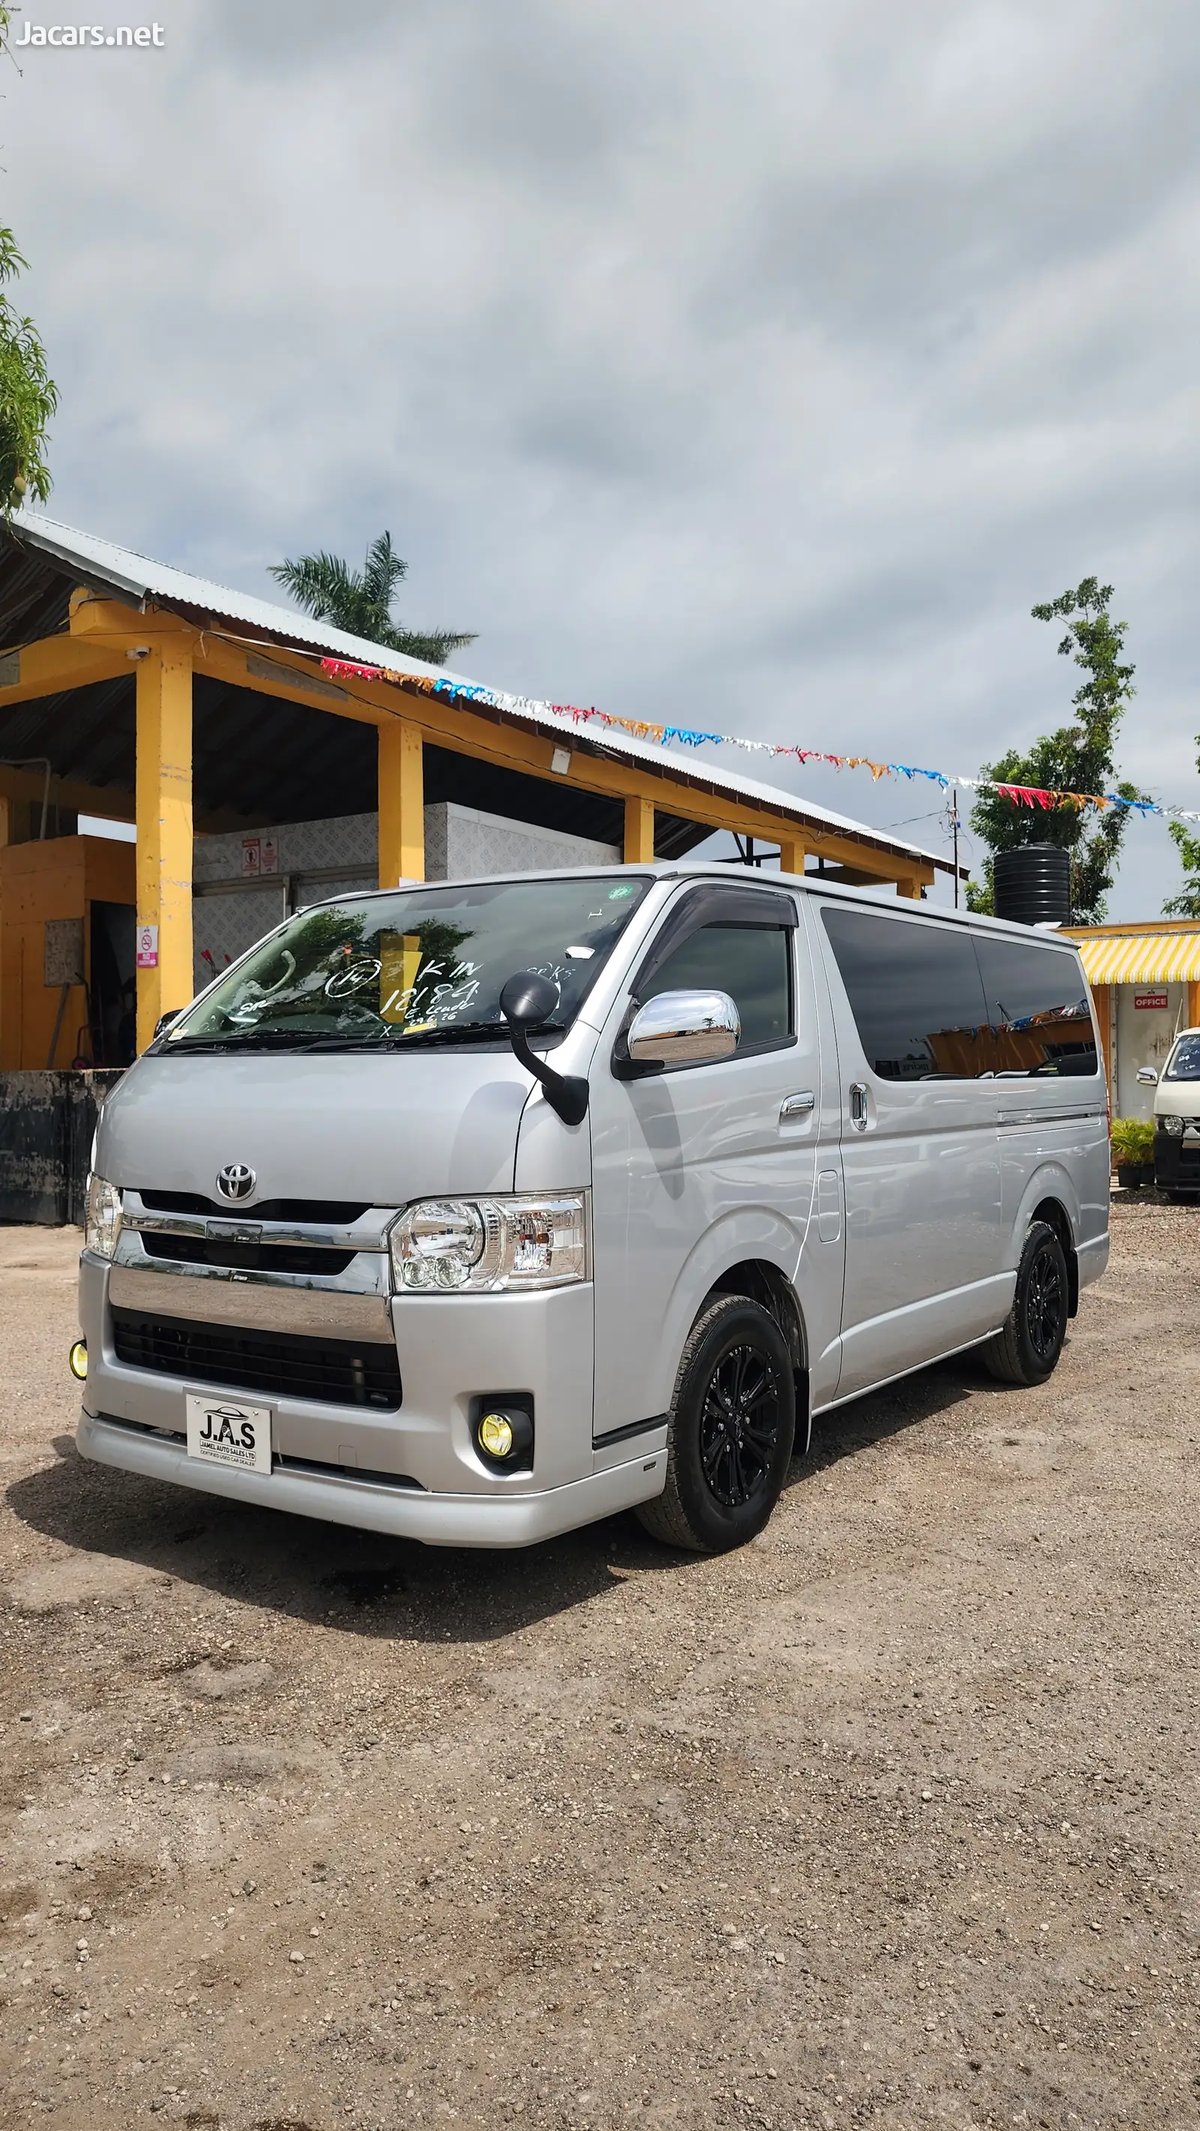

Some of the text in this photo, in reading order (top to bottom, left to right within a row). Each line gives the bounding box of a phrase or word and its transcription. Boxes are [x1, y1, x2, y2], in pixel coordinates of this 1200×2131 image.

[1135, 998, 1167, 1006] OFFICE
[200, 1415, 255, 1449] J.A.S
[200, 1441, 255, 1459] JAMEL AUTO SALES LTD
